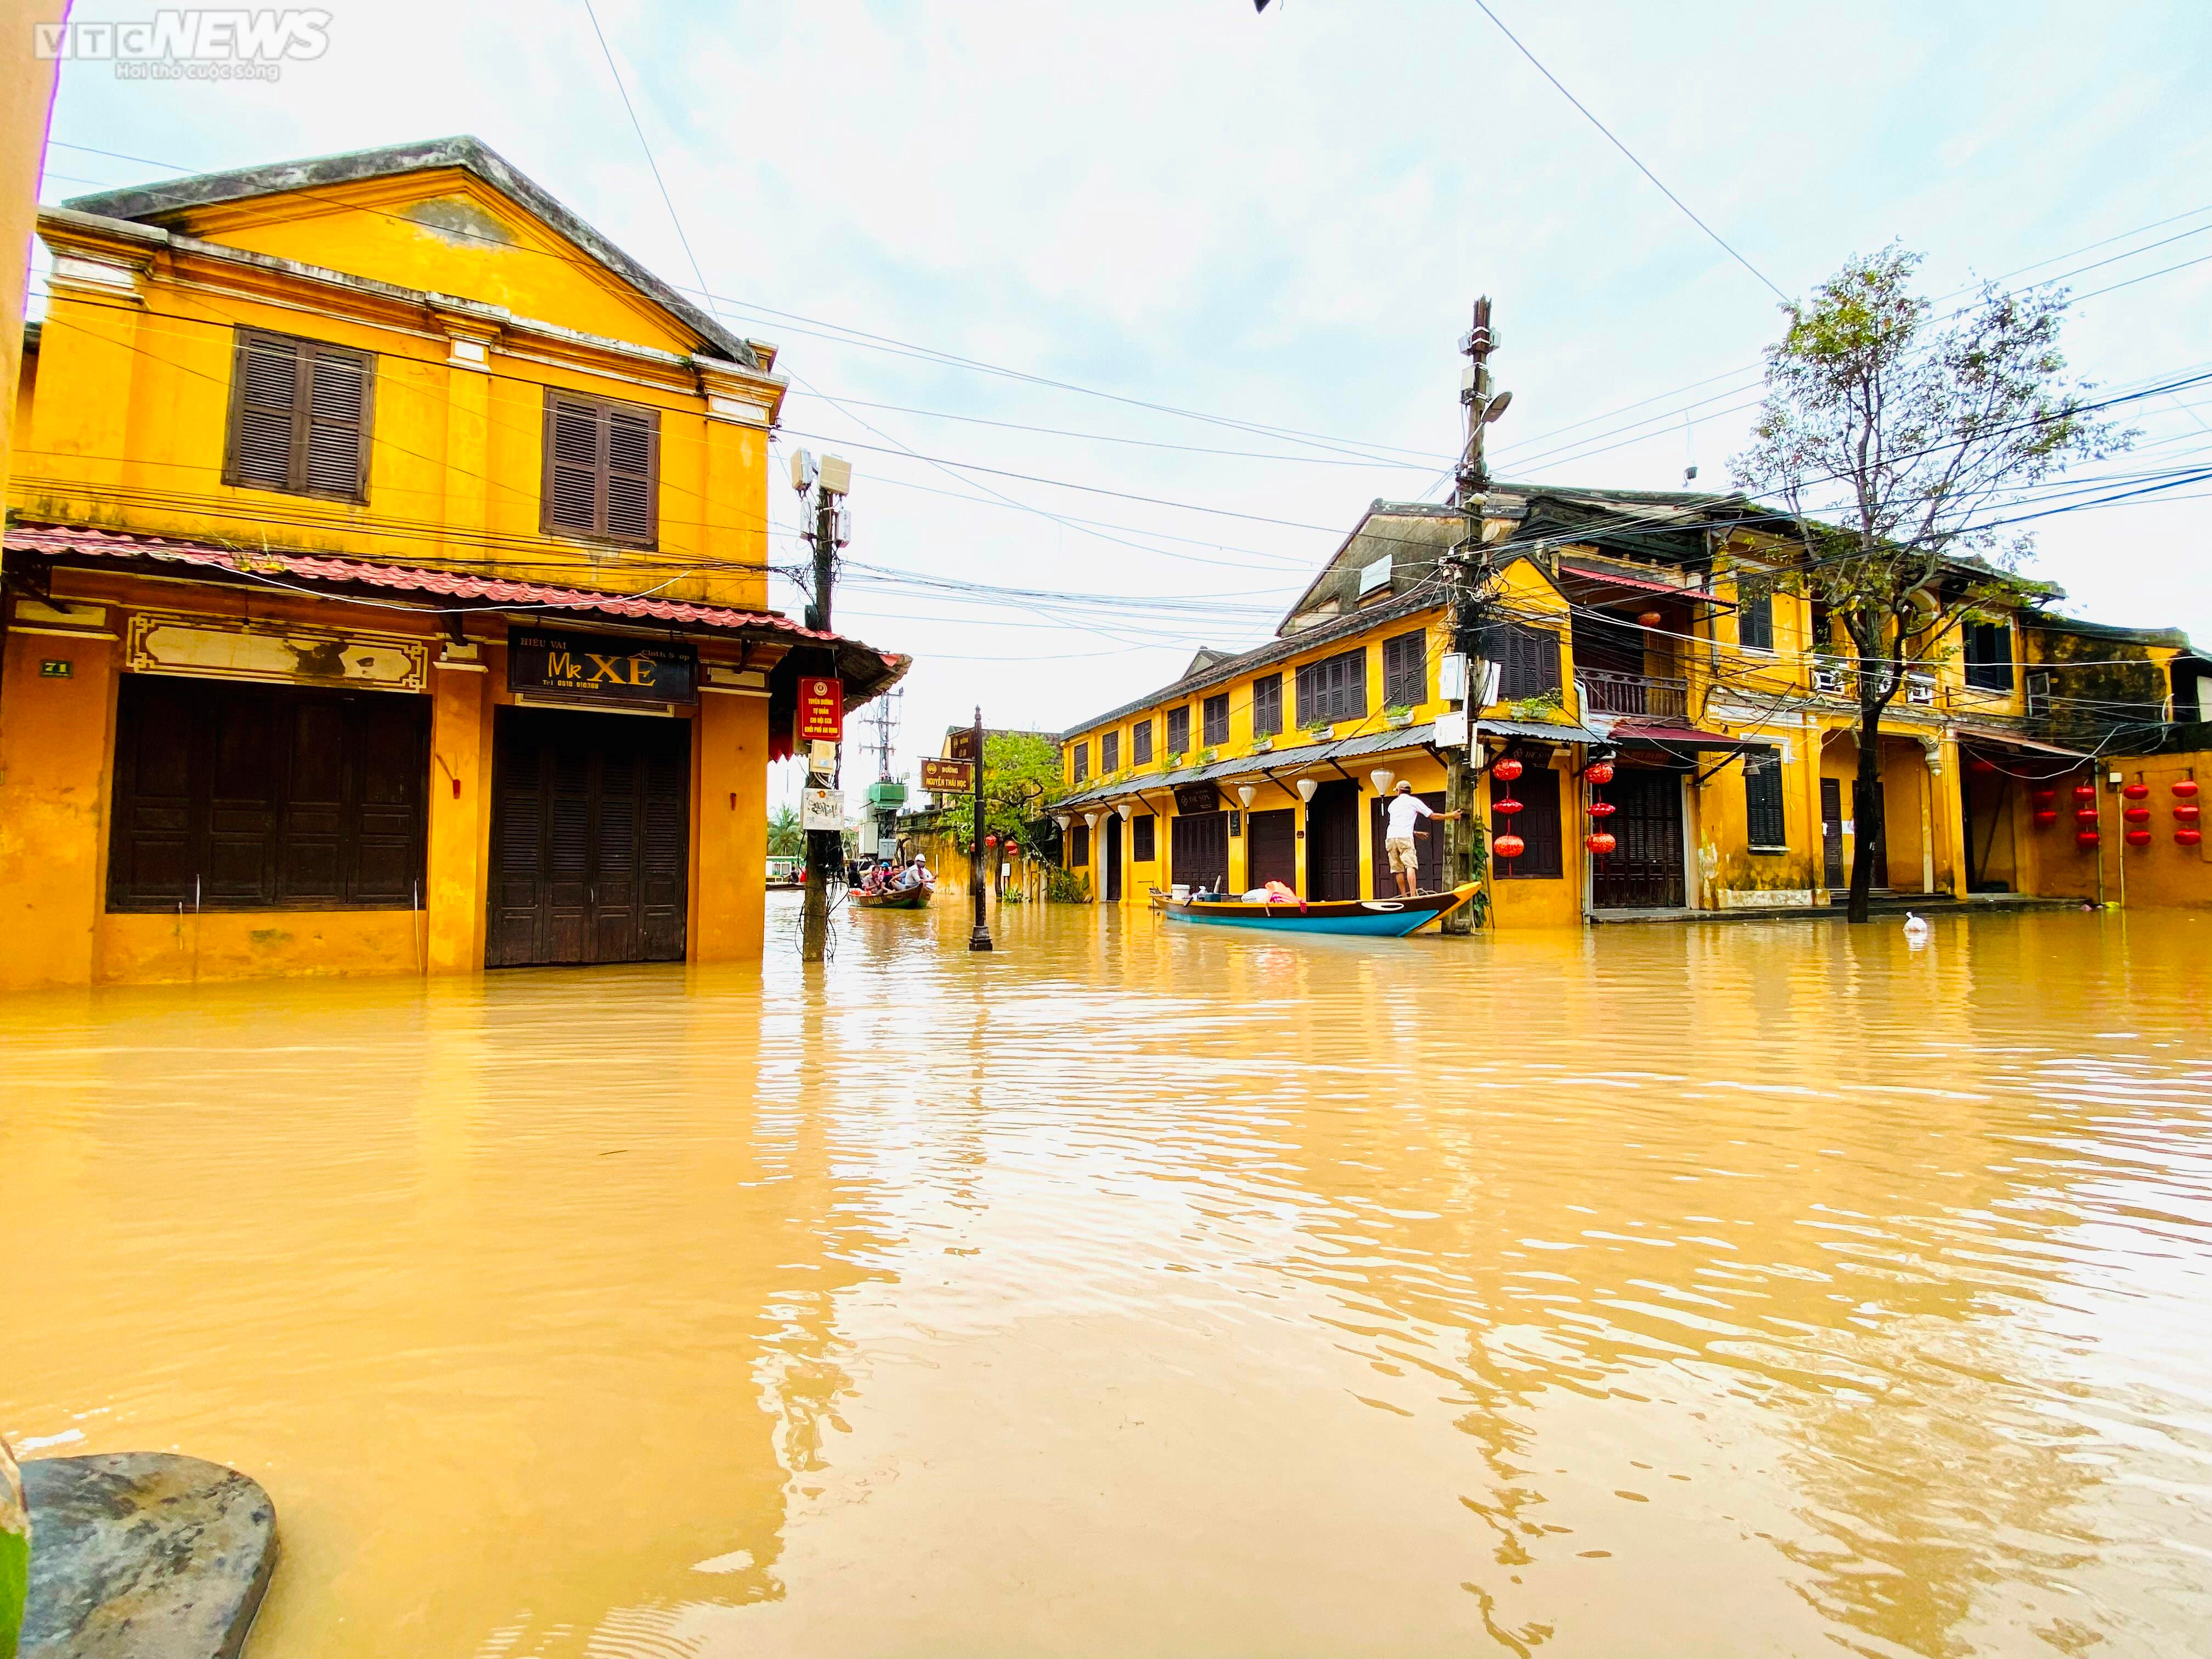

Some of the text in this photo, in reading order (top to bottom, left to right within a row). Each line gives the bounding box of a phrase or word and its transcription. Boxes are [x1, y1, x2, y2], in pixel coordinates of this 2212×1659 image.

[641, 650, 689, 661] Cloth Sop
[584, 653, 657, 686] XÊ
[942, 765, 958, 774] ĐƯỜNG
[926, 776, 945, 786] NGUYỄN
[945, 778, 956, 787] THÁI
